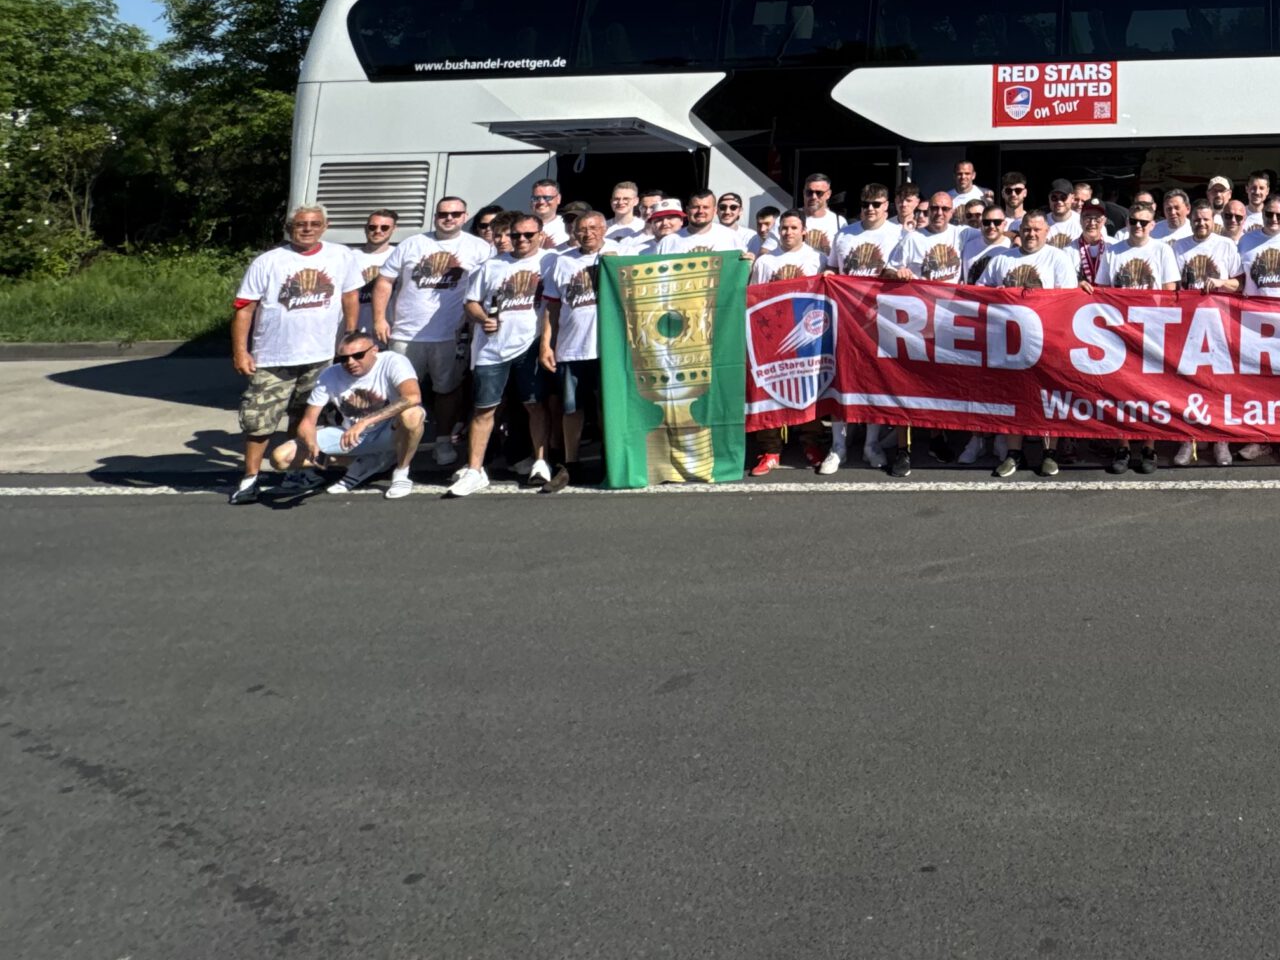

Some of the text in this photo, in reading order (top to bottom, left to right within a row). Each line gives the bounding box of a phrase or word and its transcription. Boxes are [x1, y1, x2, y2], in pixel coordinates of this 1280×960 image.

[414, 56, 567, 71] www.bushandel-roettgen.de
[998, 63, 1112, 83] RED STARS
[1044, 81, 1112, 98] UNITED
[1034, 100, 1080, 119] on Tour
[930, 266, 957, 279] FINALE
[288, 292, 326, 308] FINALE
[501, 295, 535, 310] FINALE
[876, 294, 1044, 370] RED
[756, 364, 777, 379] Red
[778, 361, 805, 372] Stars
[1040, 388, 1171, 424] Worms
[1183, 392, 1212, 426] &
